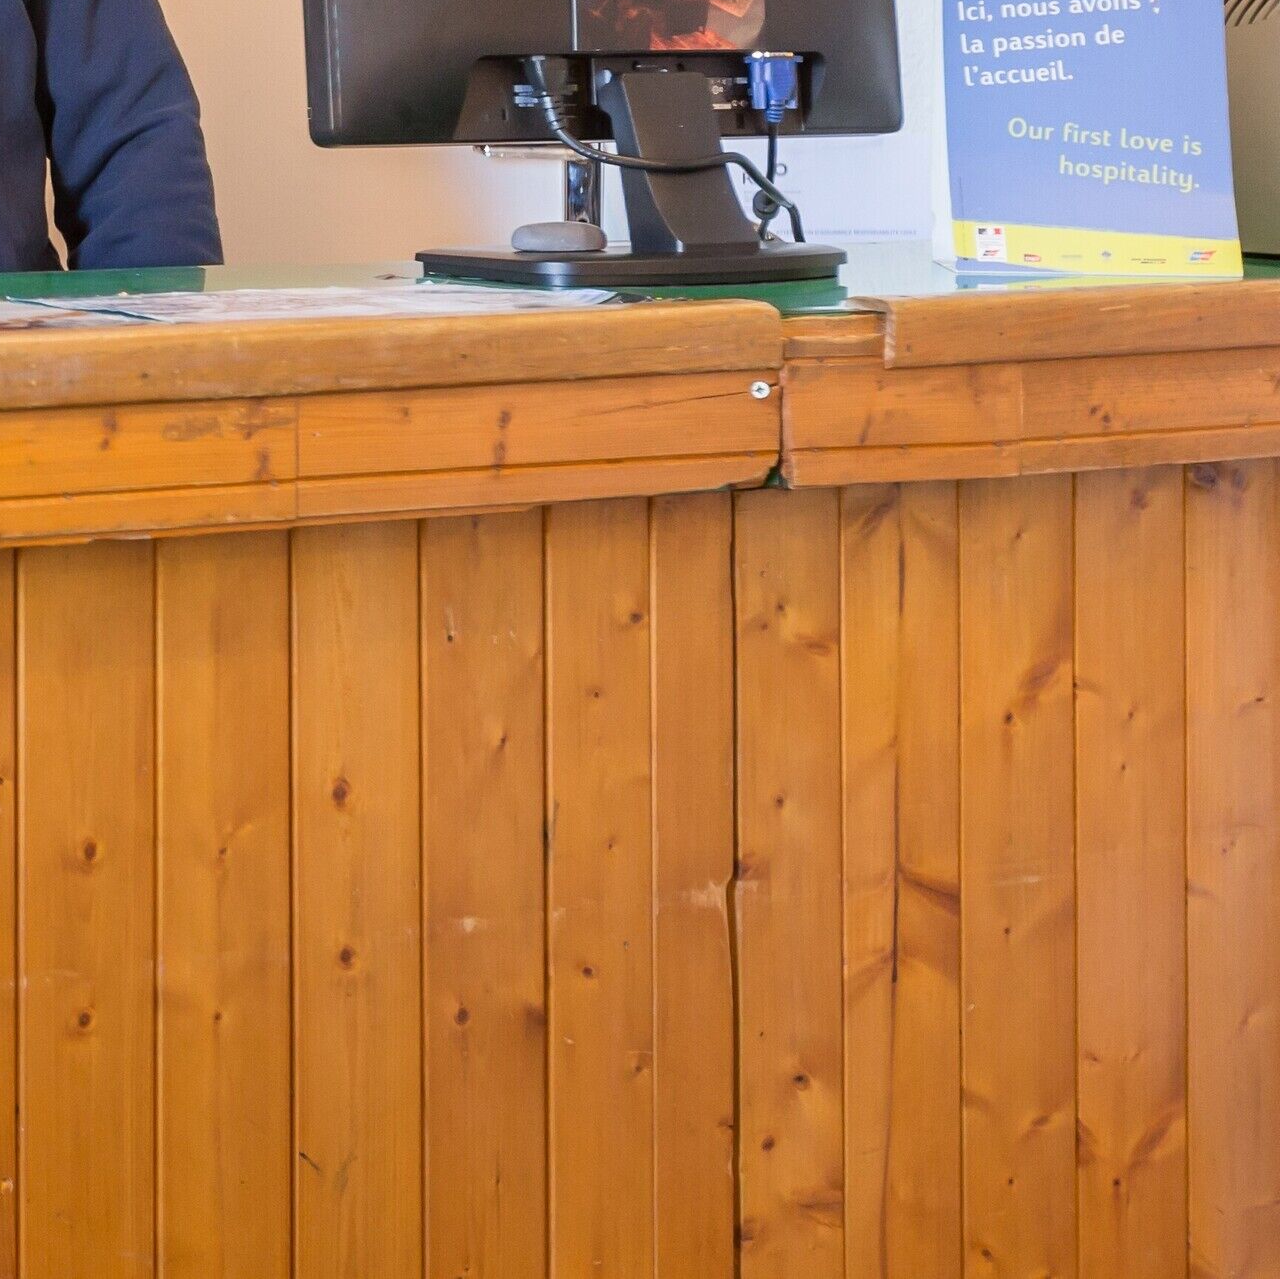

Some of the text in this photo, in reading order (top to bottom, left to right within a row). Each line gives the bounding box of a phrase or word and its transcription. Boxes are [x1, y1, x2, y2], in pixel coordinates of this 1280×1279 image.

[957, 0, 993, 22] Ici,
[1000, 0, 1061, 19] nous
[960, 23, 1126, 58] la passion de
[1008, 116, 1203, 156] Our first love is
[1058, 153, 1200, 194] hospitality.
